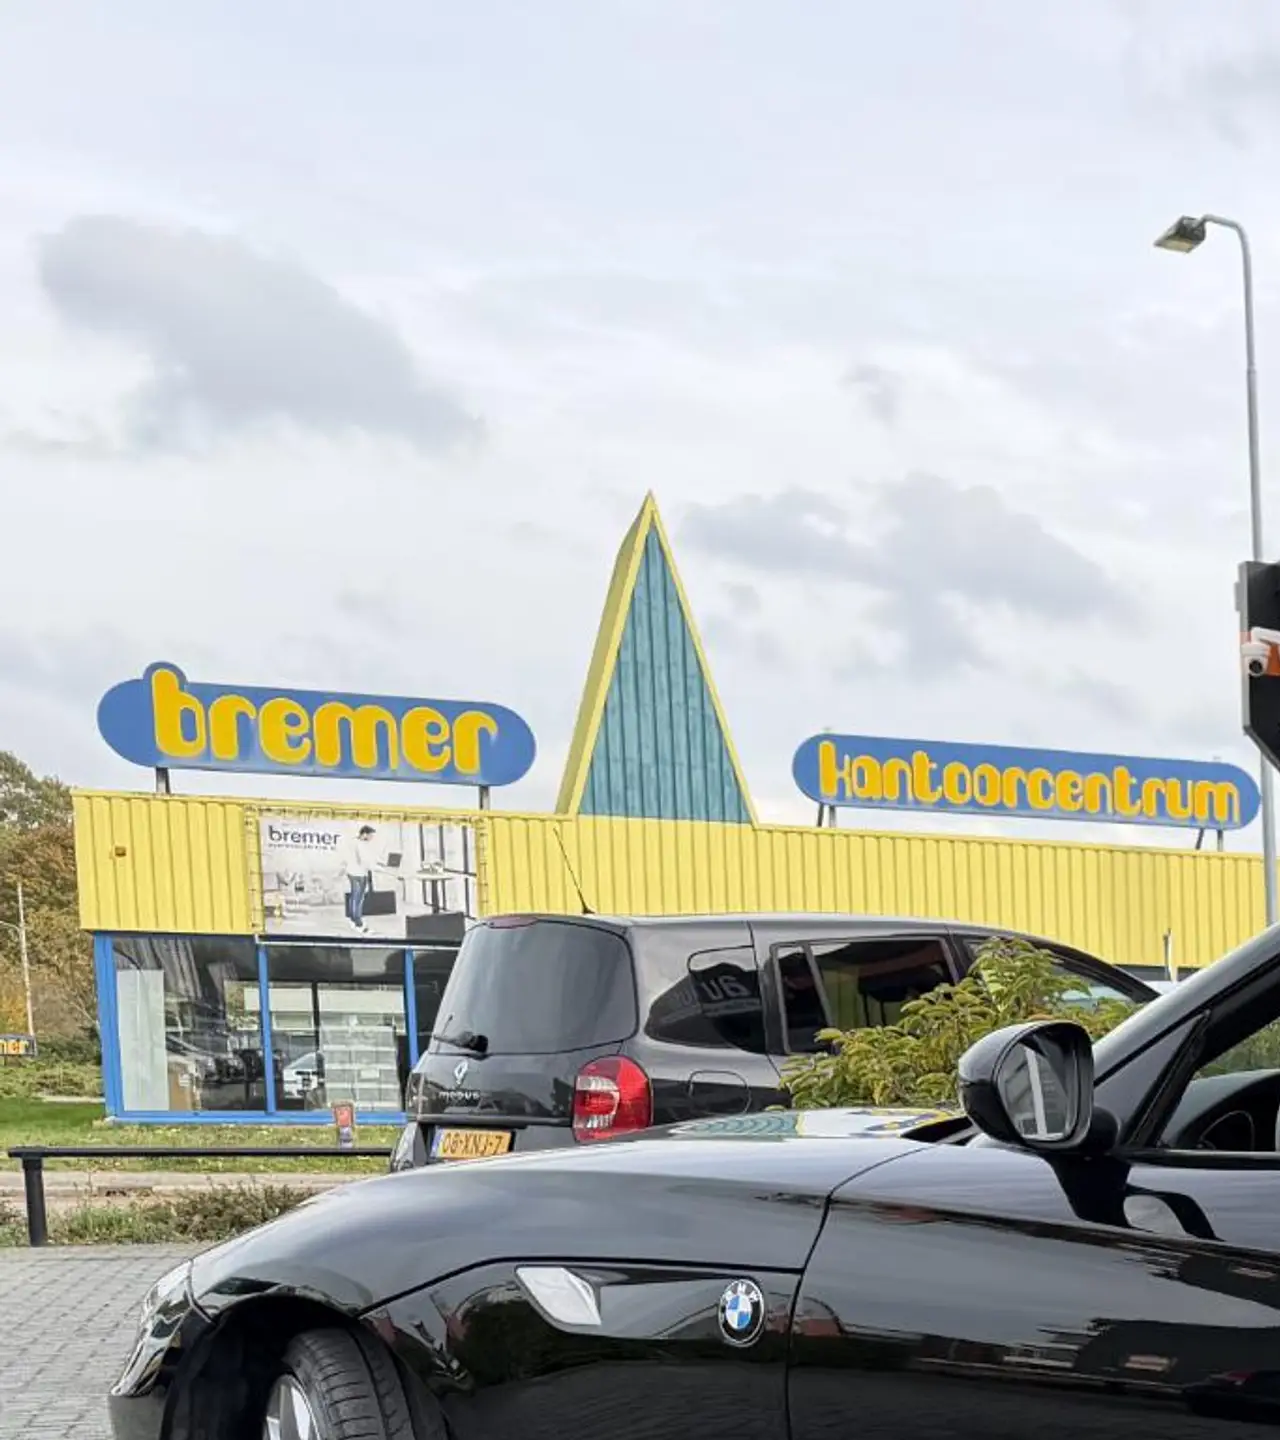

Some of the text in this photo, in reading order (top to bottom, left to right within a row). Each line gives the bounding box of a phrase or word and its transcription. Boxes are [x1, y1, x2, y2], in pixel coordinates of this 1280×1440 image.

[151, 667, 500, 774] bremer
[818, 740, 1241, 822] kantoorcentrum
[268, 825, 341, 845] bremer
